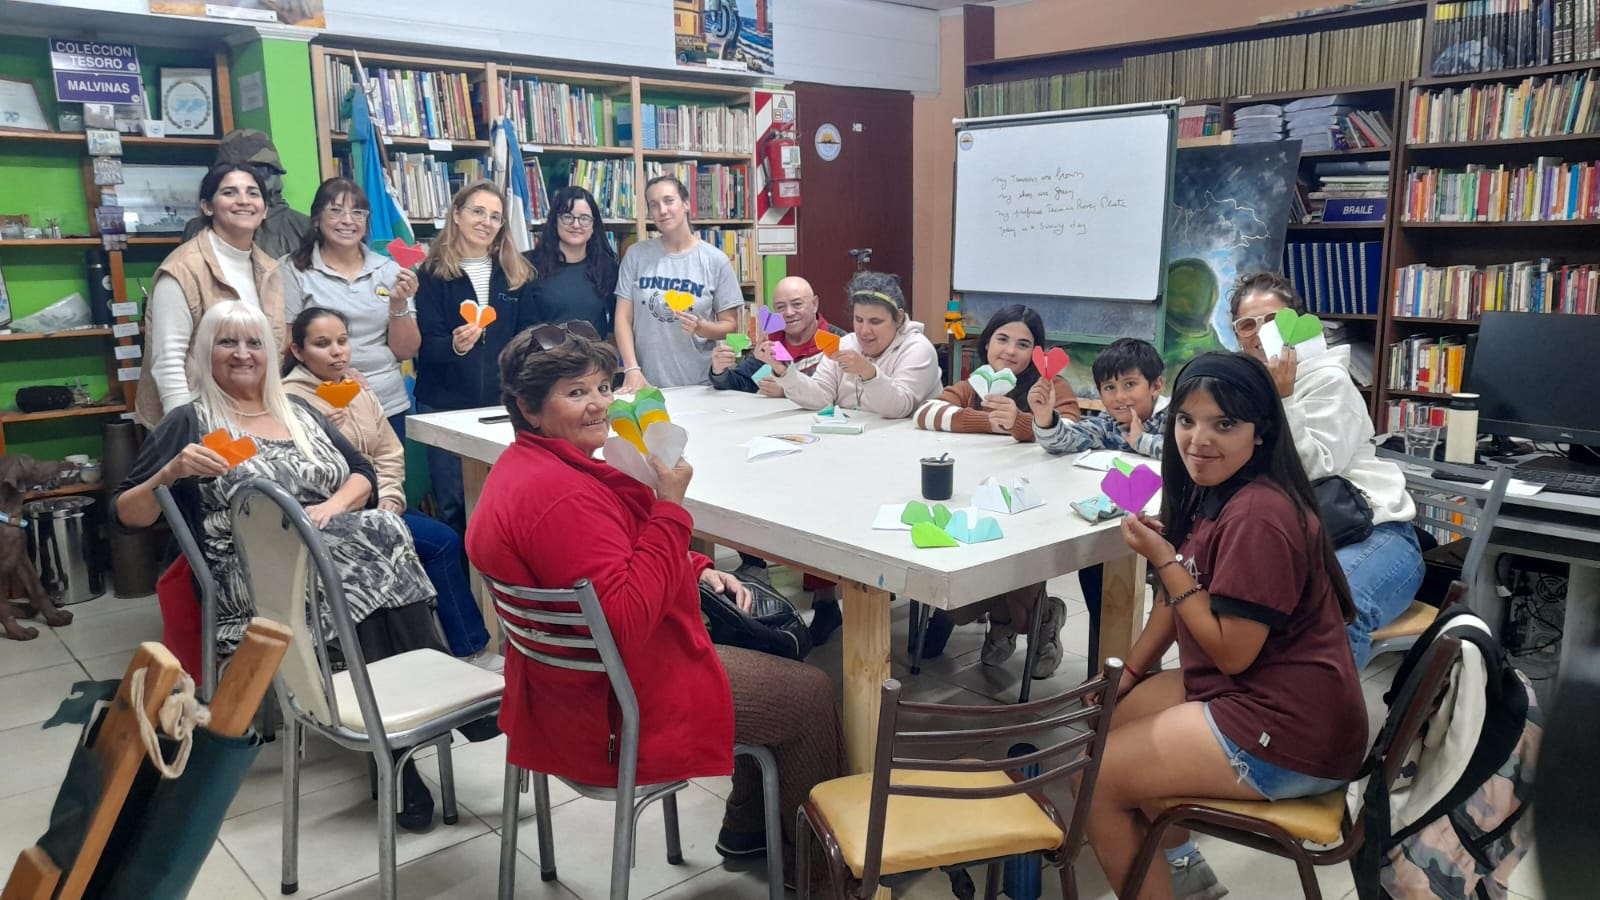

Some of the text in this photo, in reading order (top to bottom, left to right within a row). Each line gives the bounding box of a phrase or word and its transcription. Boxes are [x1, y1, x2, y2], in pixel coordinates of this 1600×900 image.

[55, 41, 132, 57] COLECCION
[70, 55, 123, 69] TESORO
[67, 79, 131, 94] MALVINAS
[1342, 204, 1375, 215] BRAILE
[639, 276, 705, 298] UNICEN
